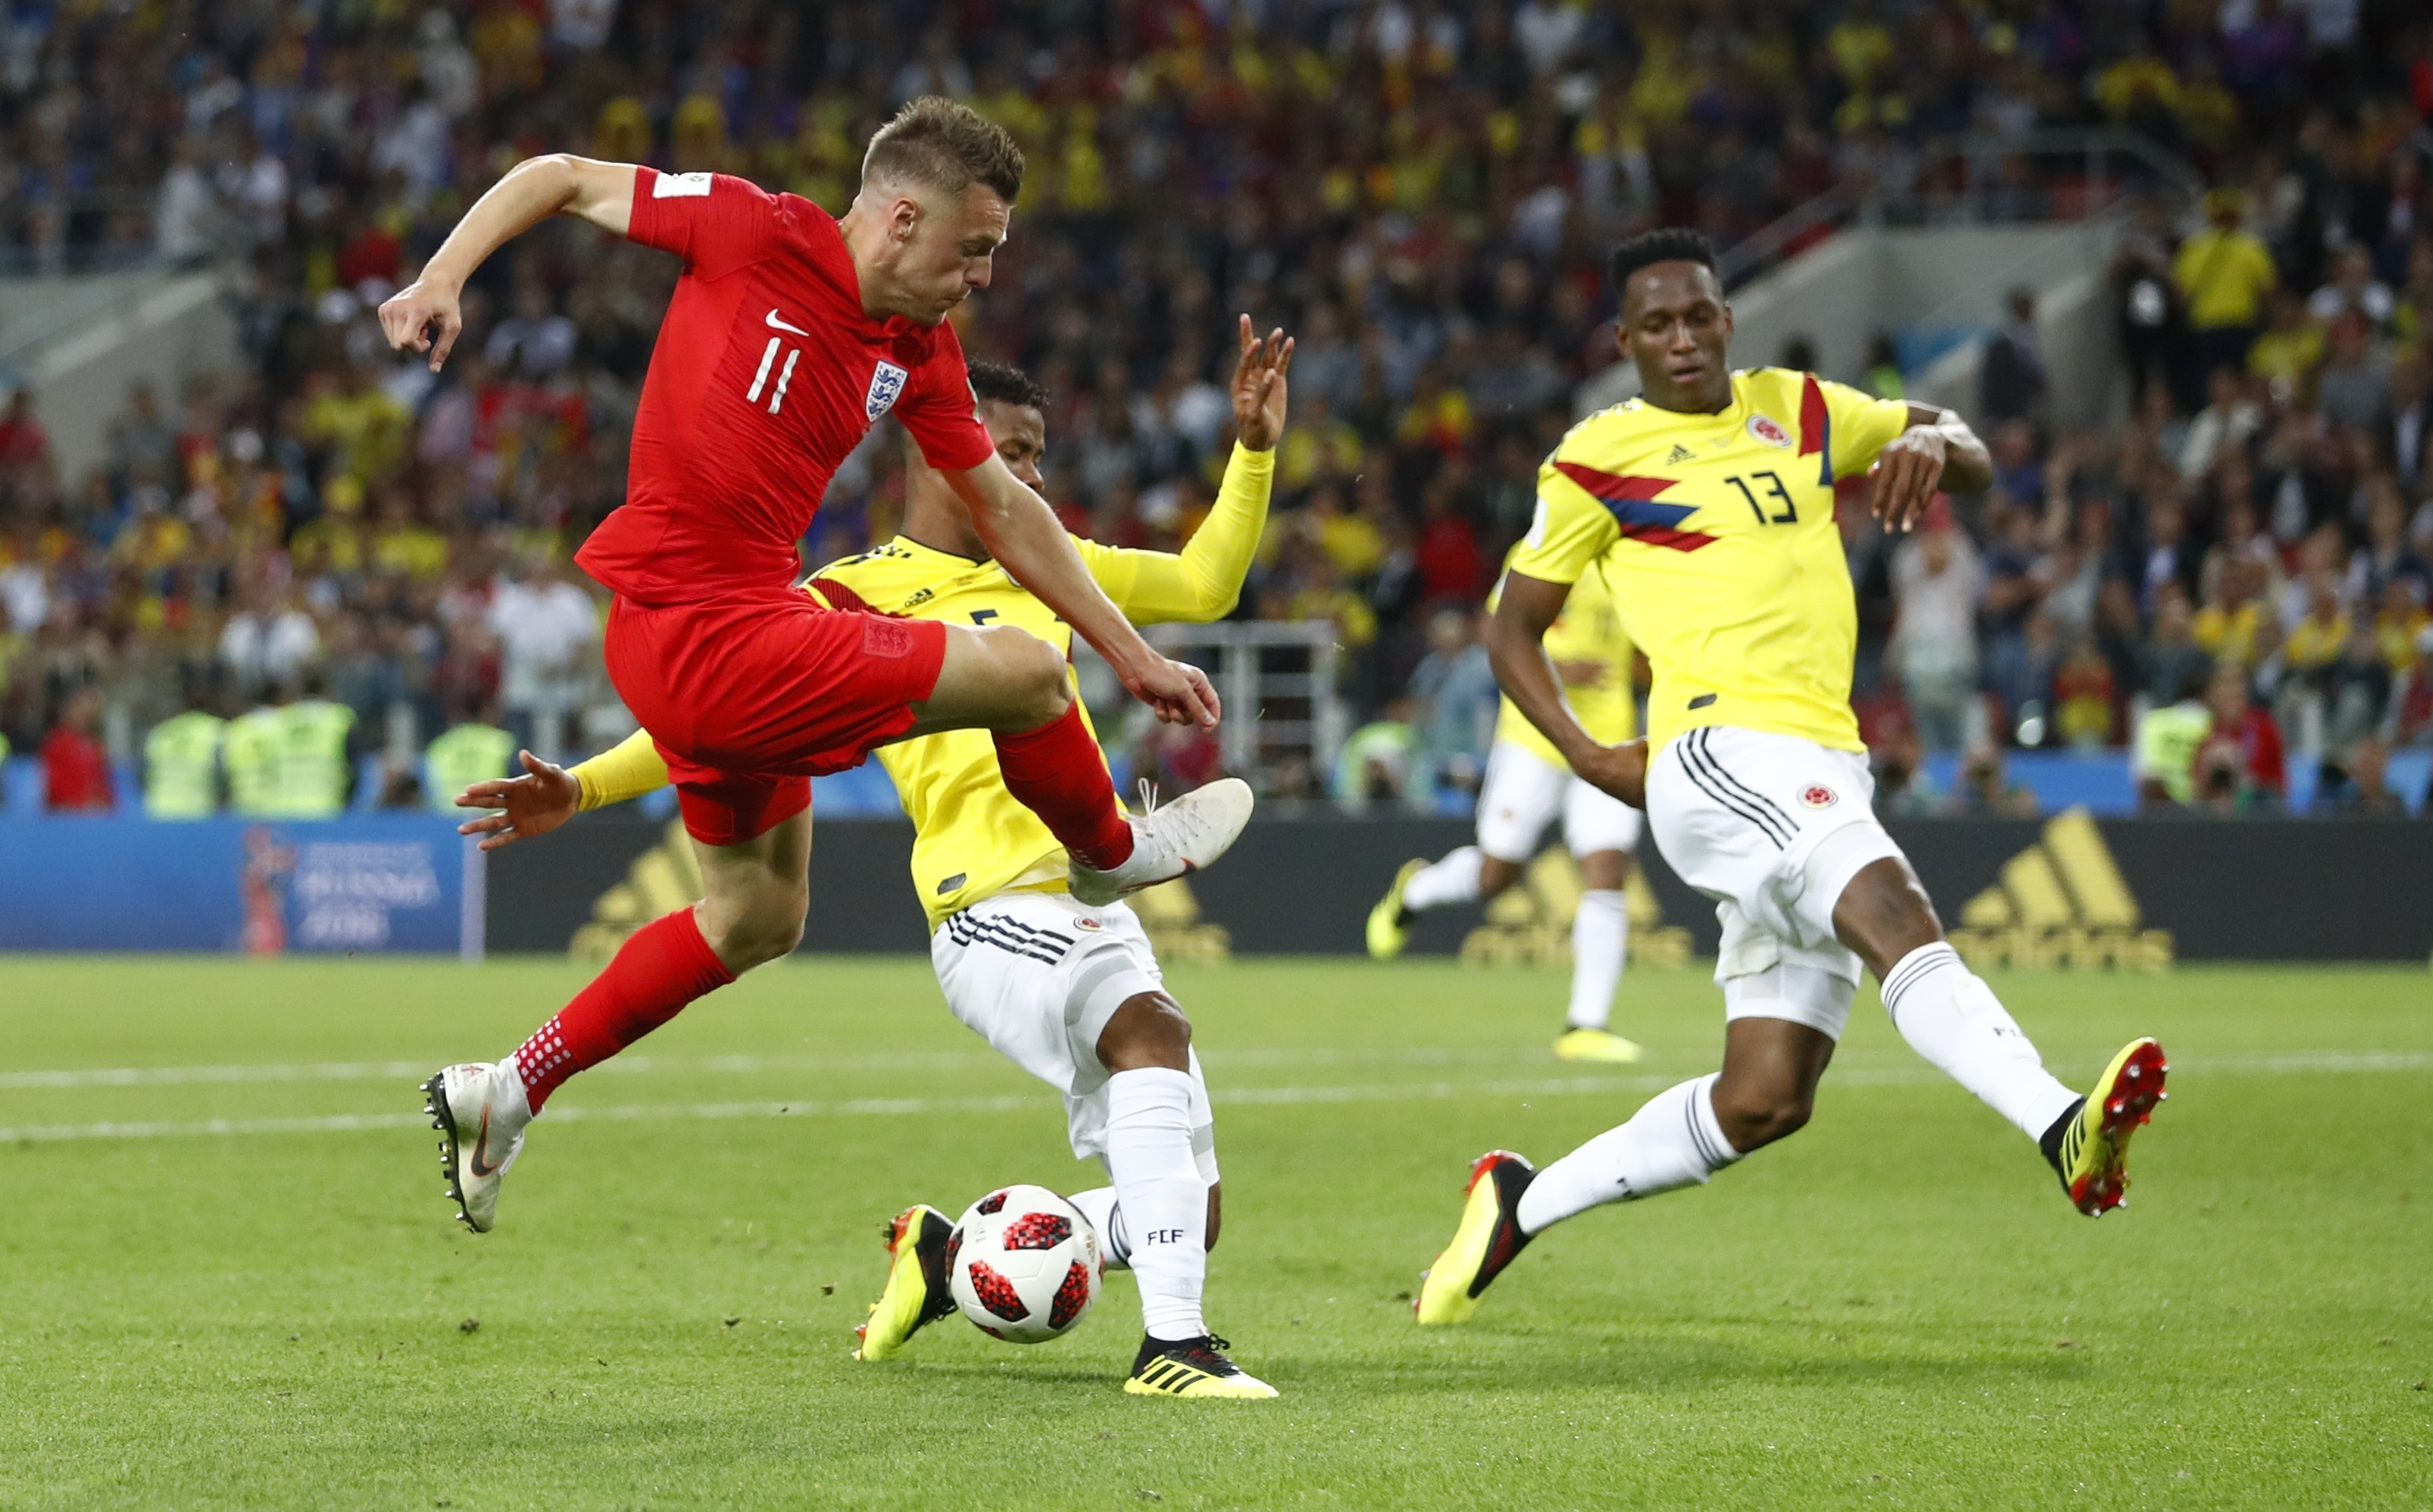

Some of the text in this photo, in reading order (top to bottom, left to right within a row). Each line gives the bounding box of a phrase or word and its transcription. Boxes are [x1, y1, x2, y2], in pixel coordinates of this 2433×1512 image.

[746, 336, 801, 415] 11
[1723, 470, 1798, 525] 13
[1148, 1229, 1184, 1246] FCF
